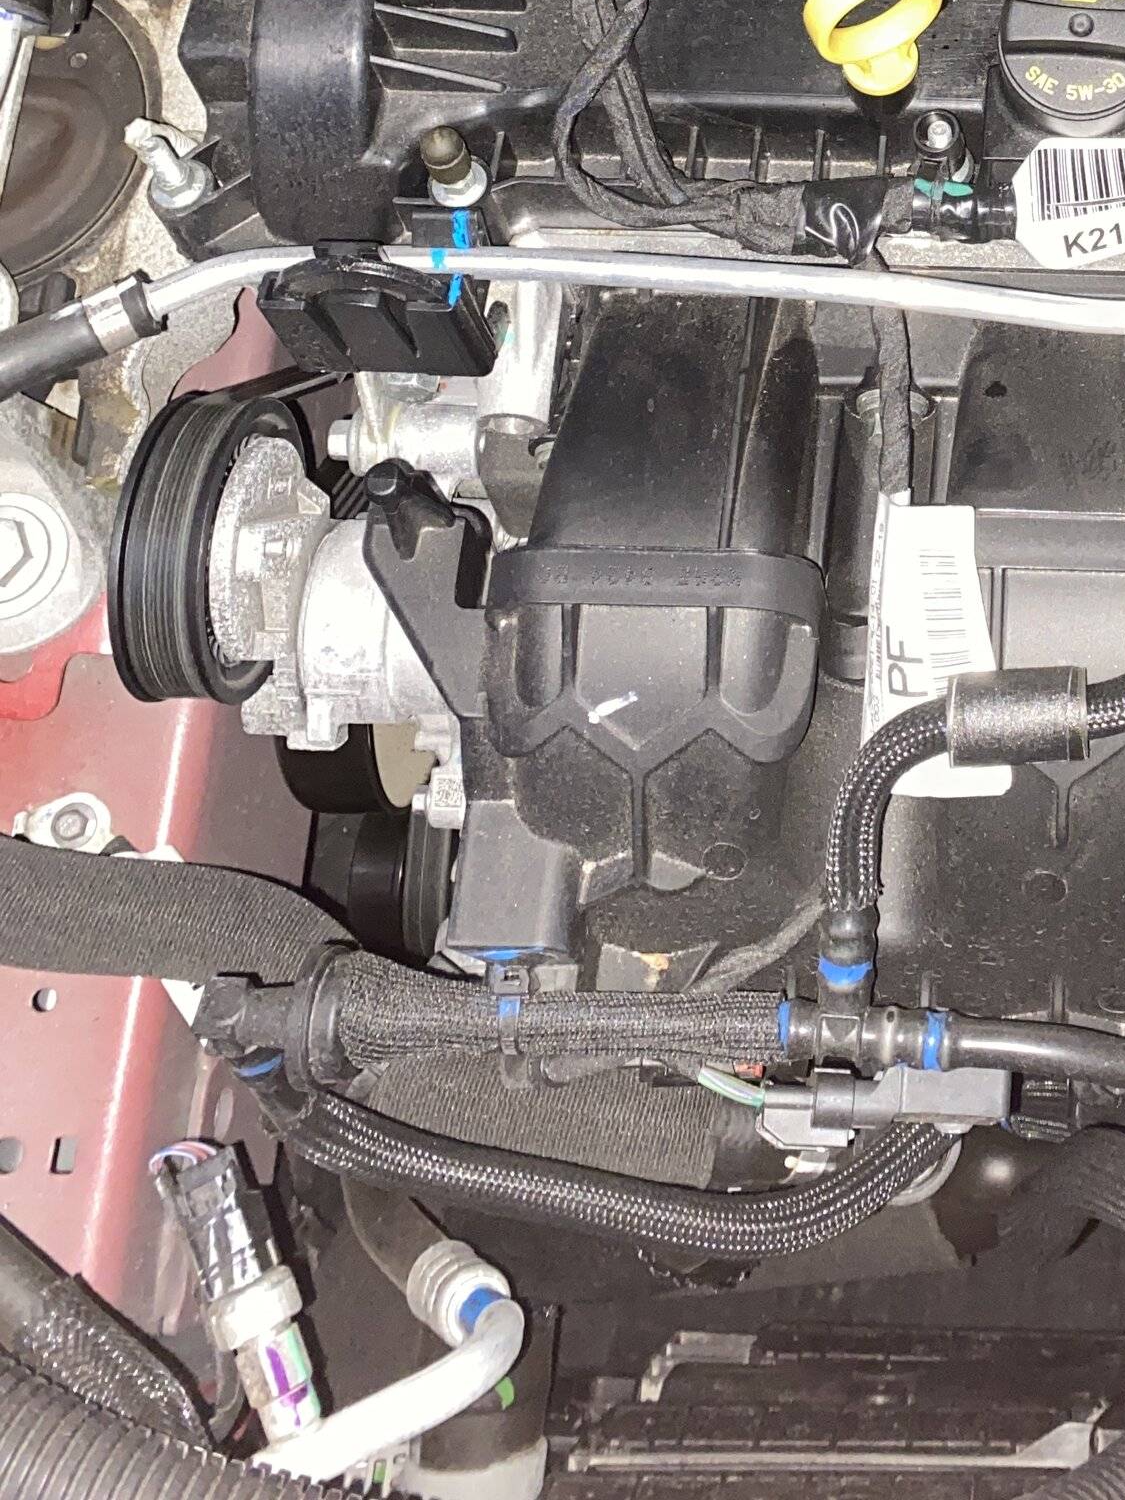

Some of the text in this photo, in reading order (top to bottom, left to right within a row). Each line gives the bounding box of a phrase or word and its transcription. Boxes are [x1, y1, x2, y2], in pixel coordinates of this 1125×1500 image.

[1025, 65, 1059, 96] SAE
[1063, 222, 1124, 259] K21
[885, 624, 929, 698] PF
